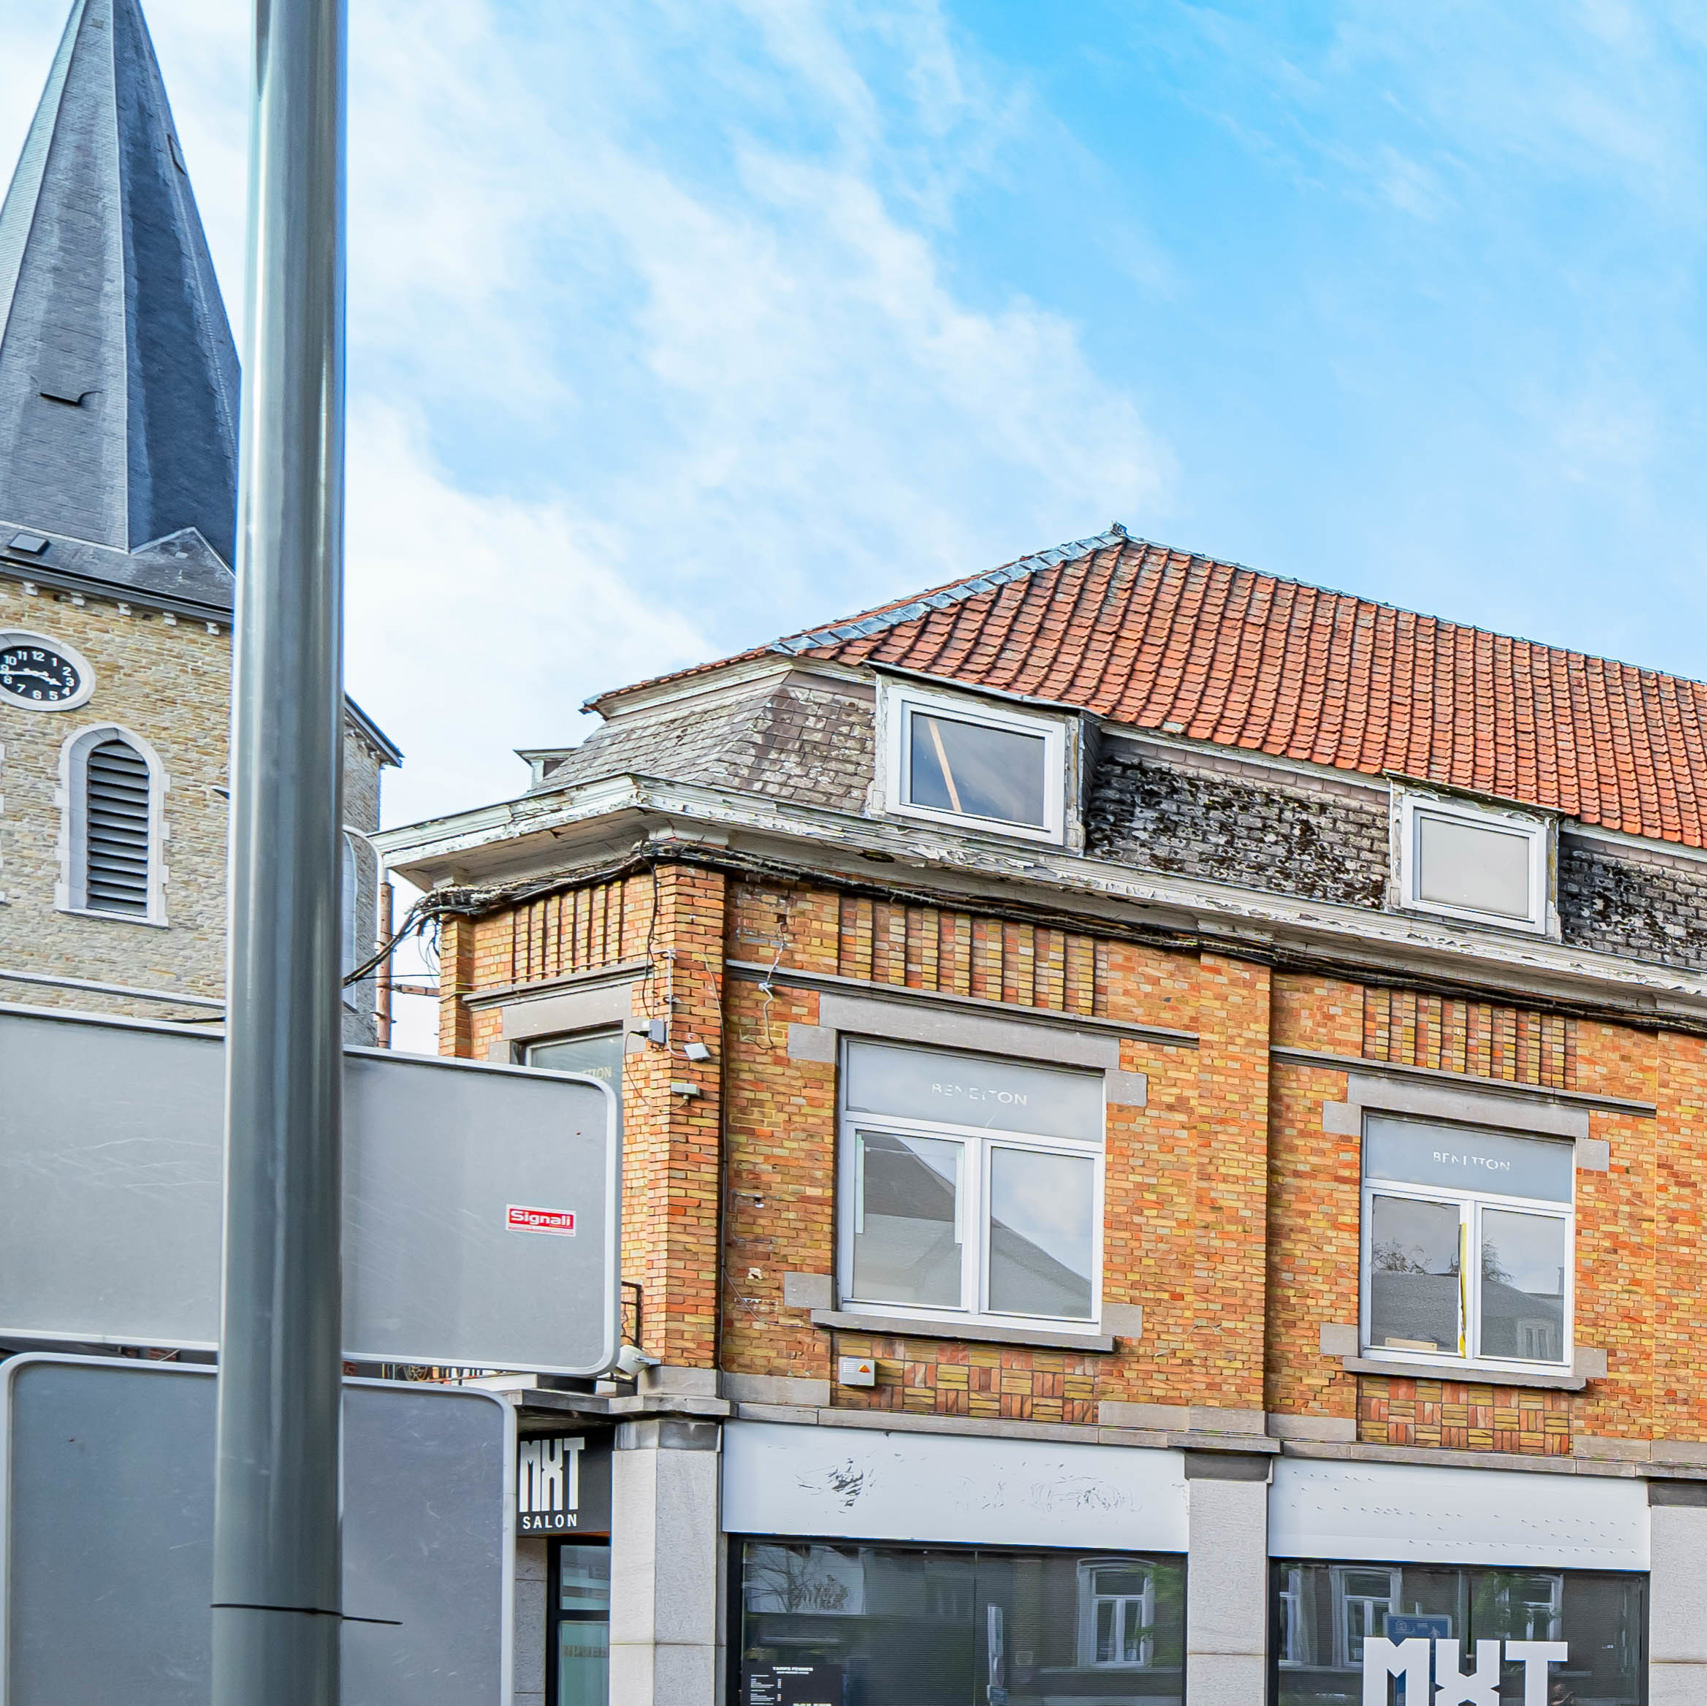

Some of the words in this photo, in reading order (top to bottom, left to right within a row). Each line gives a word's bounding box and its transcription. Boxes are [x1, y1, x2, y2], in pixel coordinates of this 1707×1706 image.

[3, 655, 17, 665] 10
[17, 650, 27, 660] 11
[32, 651, 45, 662] 12
[52, 657, 57, 667] 1
[62, 667, 72, 676] 2
[3, 675, 13, 684] 8
[65, 677, 75, 687] 3
[17, 683, 26, 693] 7
[61, 687, 71, 696] 4
[32, 690, 42, 699] 6
[49, 691, 58, 700] 5
[510, 1210, 572, 1226] Signali
[522, 1514, 578, 1530] SALON
